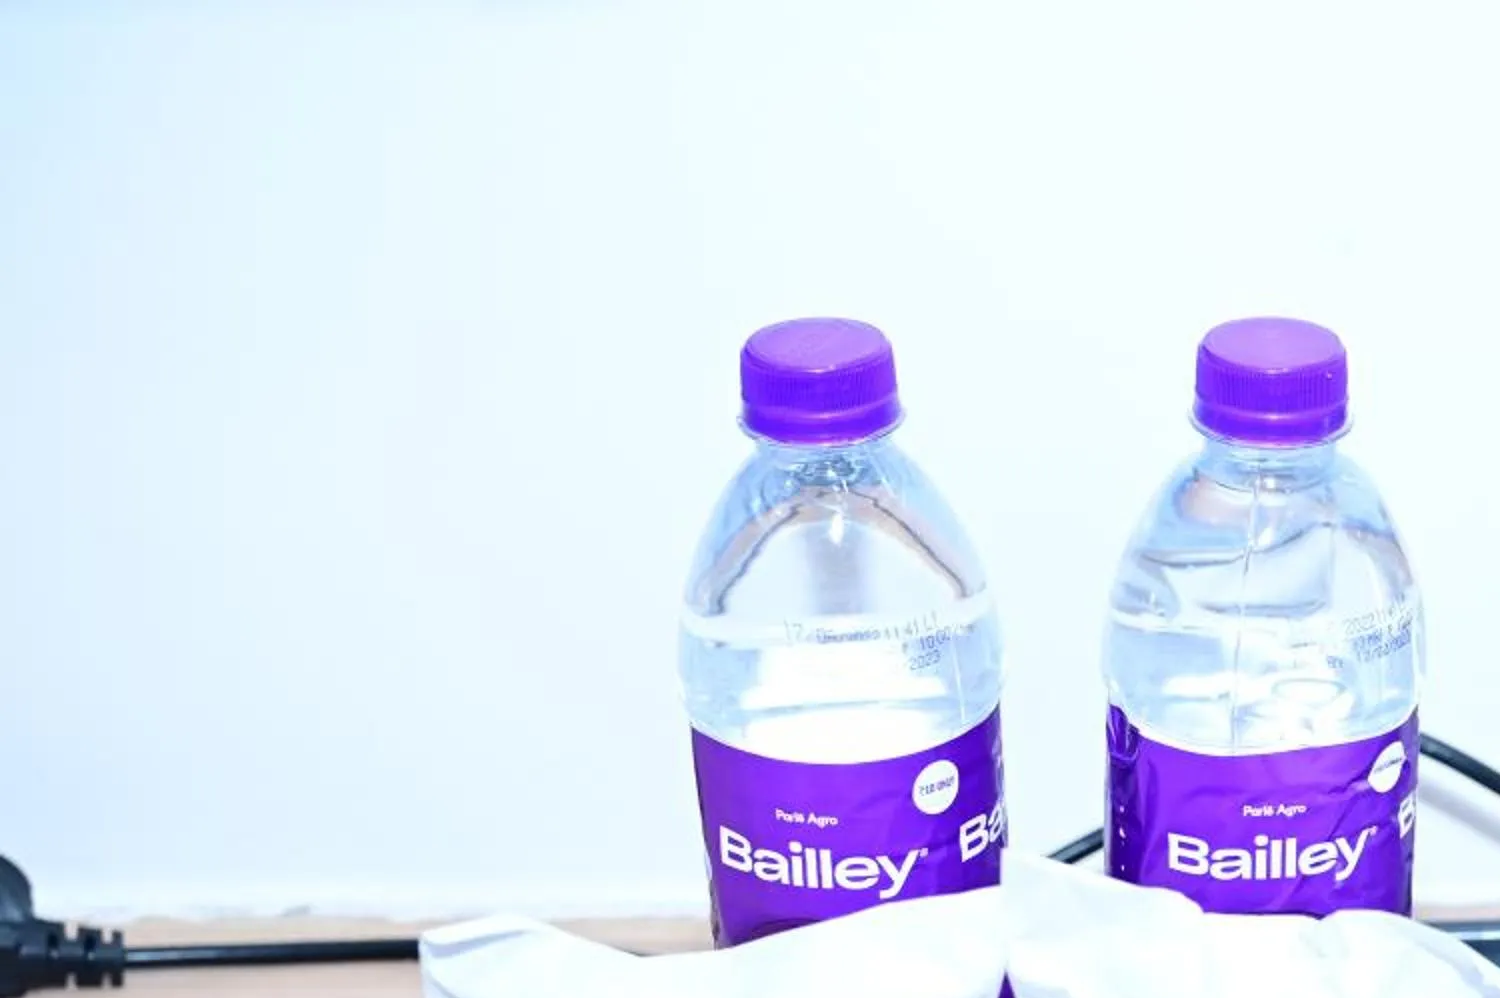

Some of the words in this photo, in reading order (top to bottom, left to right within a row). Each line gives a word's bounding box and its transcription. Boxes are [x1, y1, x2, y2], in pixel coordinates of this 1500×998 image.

[807, 811, 839, 829] Agro
[1276, 803, 1307, 818] Agro
[719, 825, 918, 900] Bailley
[1167, 826, 1370, 882] Bailley
